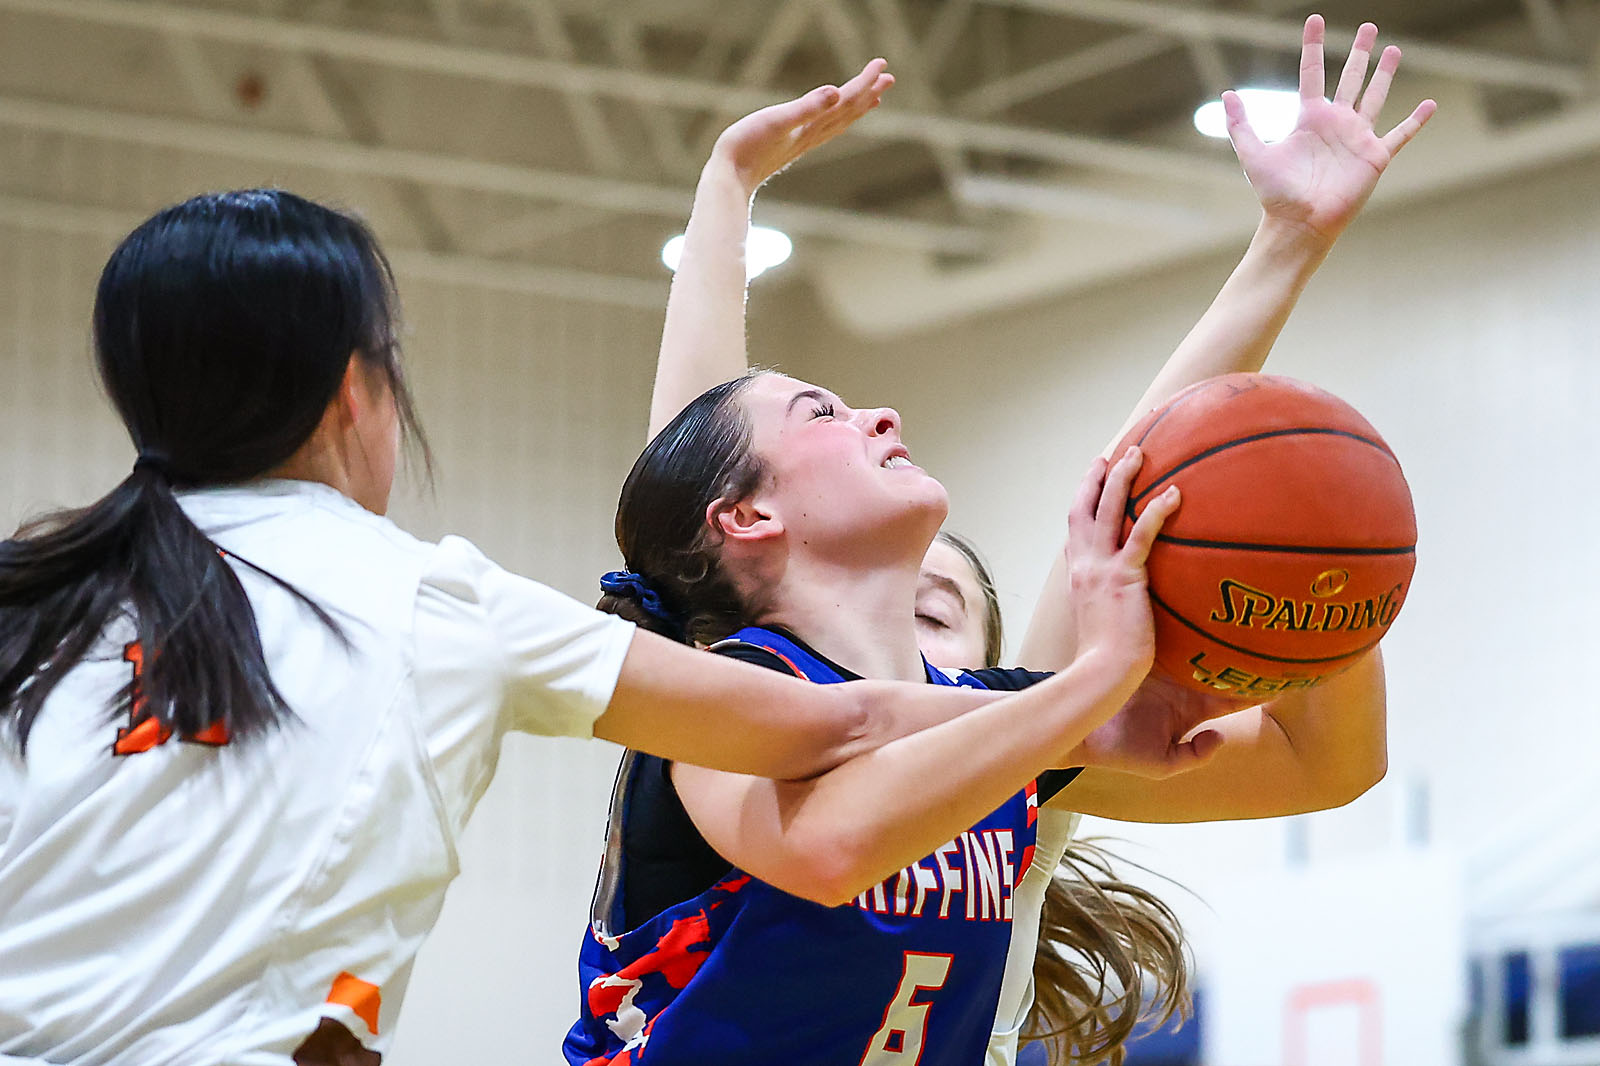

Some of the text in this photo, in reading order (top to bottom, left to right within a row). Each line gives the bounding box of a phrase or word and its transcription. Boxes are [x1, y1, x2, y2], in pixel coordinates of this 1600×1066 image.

[1209, 578, 1402, 632] SPALDING
[1187, 651, 1322, 691] LEGA
[859, 950, 954, 1066] 6
